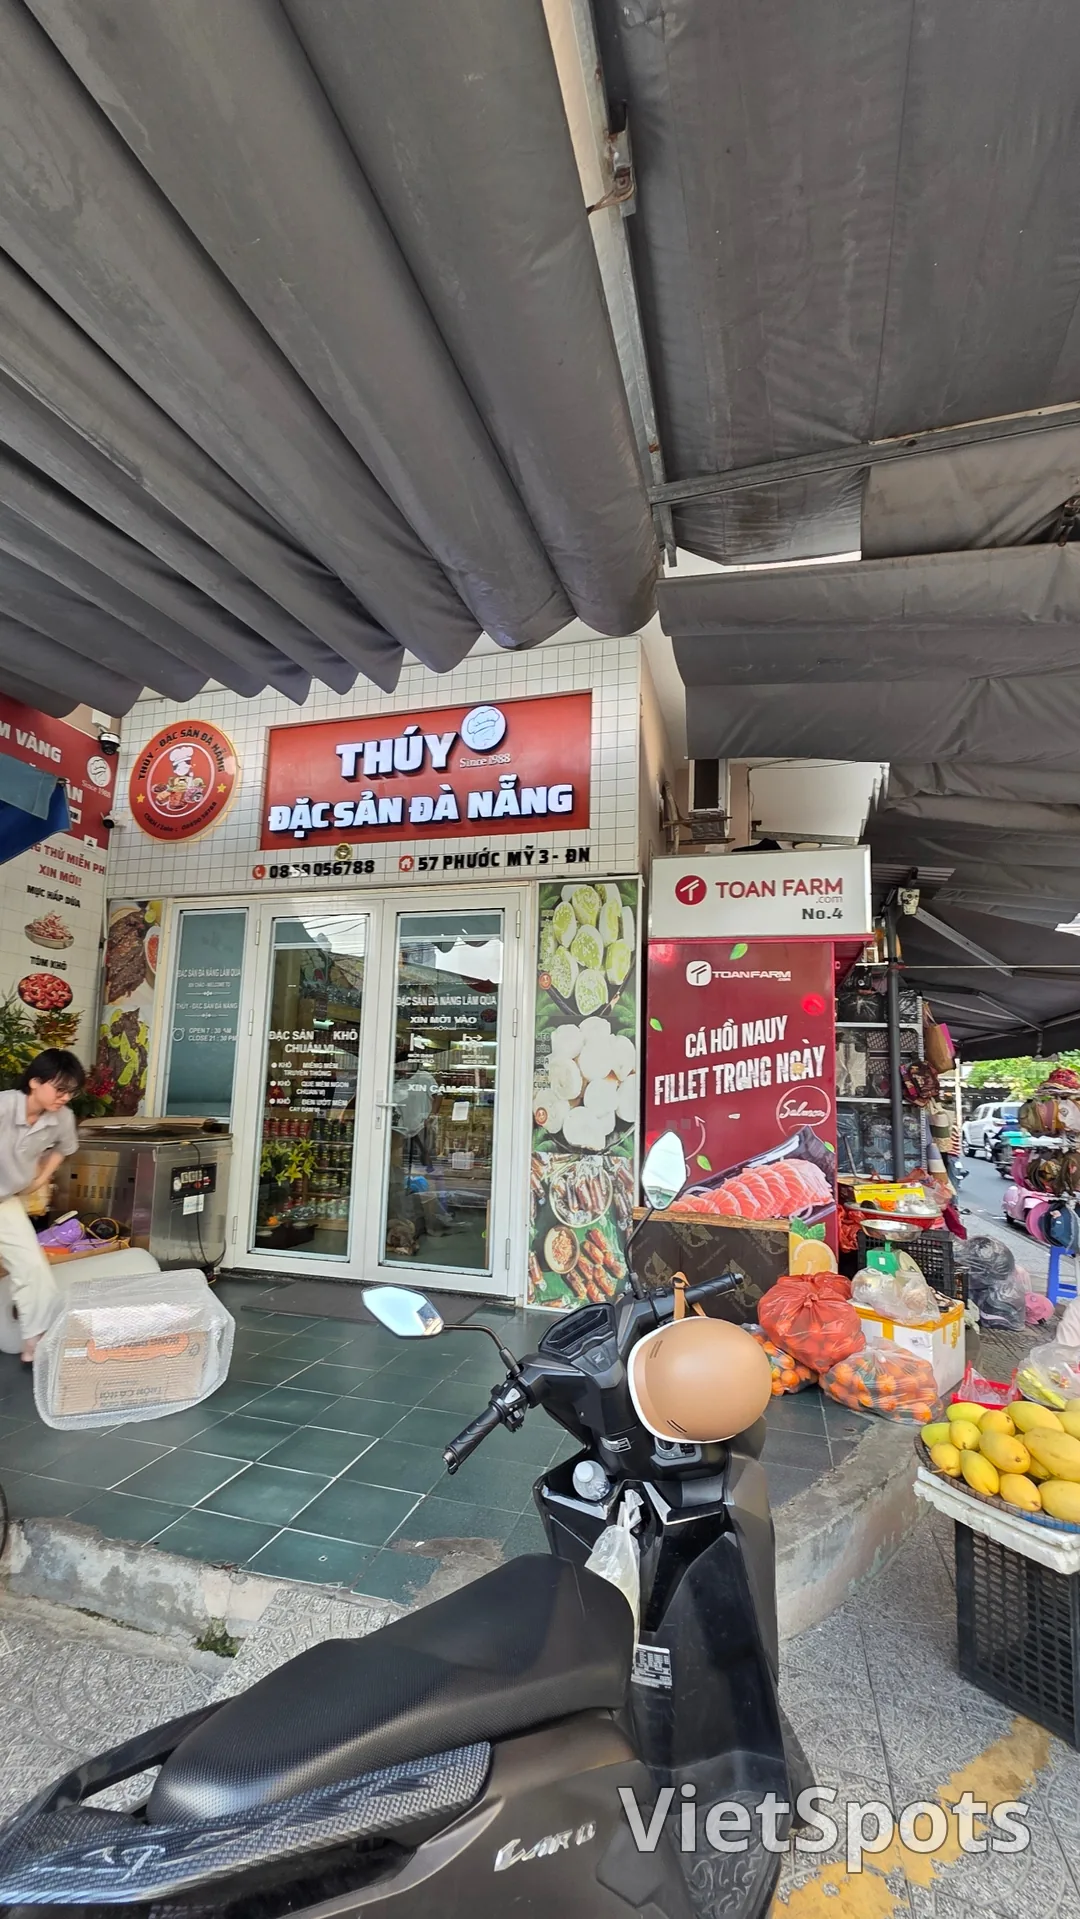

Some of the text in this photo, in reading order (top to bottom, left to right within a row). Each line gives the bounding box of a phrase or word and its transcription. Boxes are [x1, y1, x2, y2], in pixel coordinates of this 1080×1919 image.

[180, 726, 200, 738] SẢN
[200, 733, 215, 746] ĐÀ
[16, 729, 62, 763] VÀNG
[336, 725, 459, 780] THÚY
[460, 753, 512, 769] Since 1988
[82, 779, 97, 793] Since
[268, 774, 573, 838] ĐẶC SẢN ĐÀ NẴNG
[44, 844, 65, 861] THỬ
[67, 853, 91, 870] MIỄN
[418, 856, 438, 871] 57
[443, 847, 500, 870] PHƯỚC
[507, 845, 535, 866] MỸ
[539, 849, 549, 864] 3
[565, 847, 590, 863] ĐN
[38, 864, 57, 879] XIN
[27, 884, 45, 899] MỰC
[47, 889, 64, 903] HẤP
[715, 877, 843, 899] TOAN FARM
[816, 896, 843, 904] .com
[802, 908, 843, 920] No.4
[30, 955, 67, 971] TÔM KHÔ
[412, 995, 428, 1006] SẢN
[463, 994, 479, 1006] LÀM
[430, 1014, 451, 1023] MỜI
[454, 1015, 477, 1024] VÀO
[268, 1028, 358, 1041] ĐẶC SẢN KHÔ
[685, 1015, 788, 1058] CÁ HỒI NAUY
[654, 1039, 826, 1106] FILLET TRONG NGÀY
[407, 1084, 427, 1092] XIN
